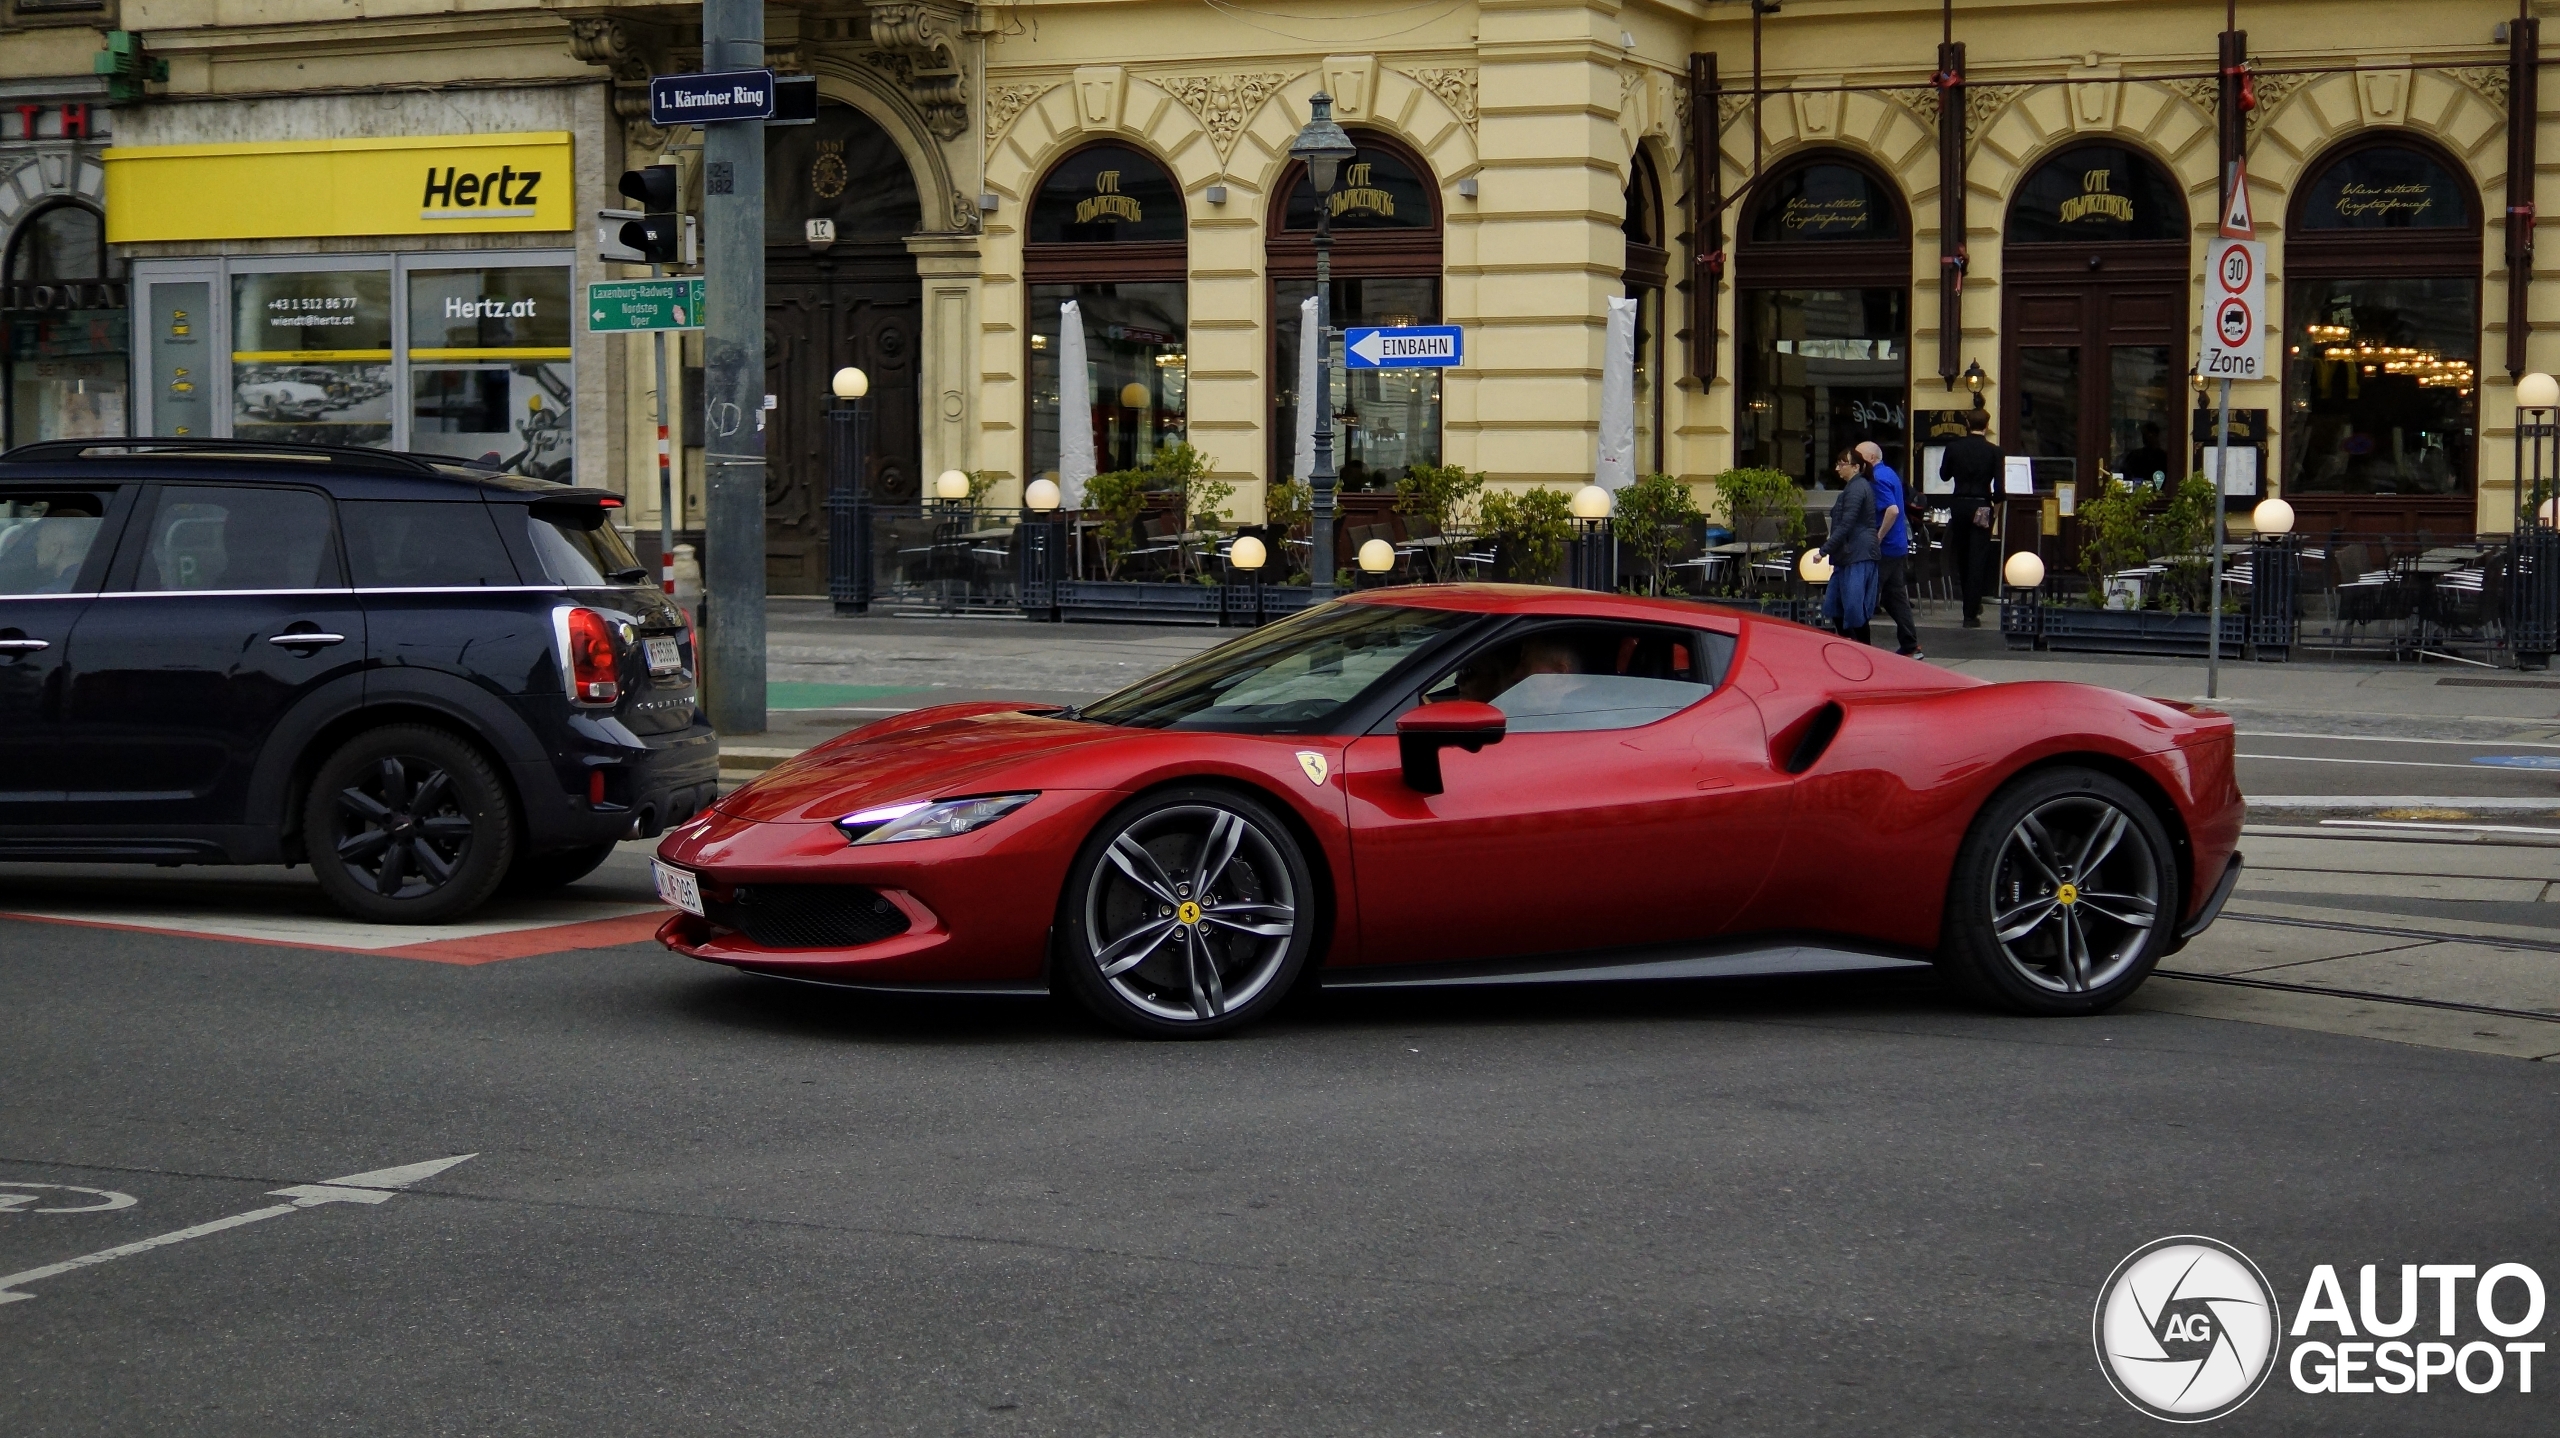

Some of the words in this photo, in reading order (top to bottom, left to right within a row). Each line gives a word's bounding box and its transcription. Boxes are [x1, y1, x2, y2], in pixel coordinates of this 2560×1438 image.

[675, 91, 732, 108] Kärntner
[733, 86, 764, 107] Ring
[422, 165, 542, 208] Hertz
[2341, 182, 2382, 195] Wiens
[1074, 195, 1142, 224] SCHWARZENBERG
[2059, 193, 2134, 223] SCHWARZENBERG
[813, 220, 829, 236] 17
[2228, 257, 2244, 281] 30
[593, 285, 674, 300] Laxenburg-Radweg
[267, 299, 290, 311] +43
[292, 298, 299, 310] 1
[301, 298, 323, 310] 512
[325, 297, 341, 309] 86
[342, 297, 358, 309] 77
[445, 297, 537, 319] Hertz.at
[621, 303, 659, 315] Nordsteg
[630, 315, 651, 328] Oper
[1382, 338, 1448, 356] EINBAHN
[2208, 348, 2256, 374] Zone
